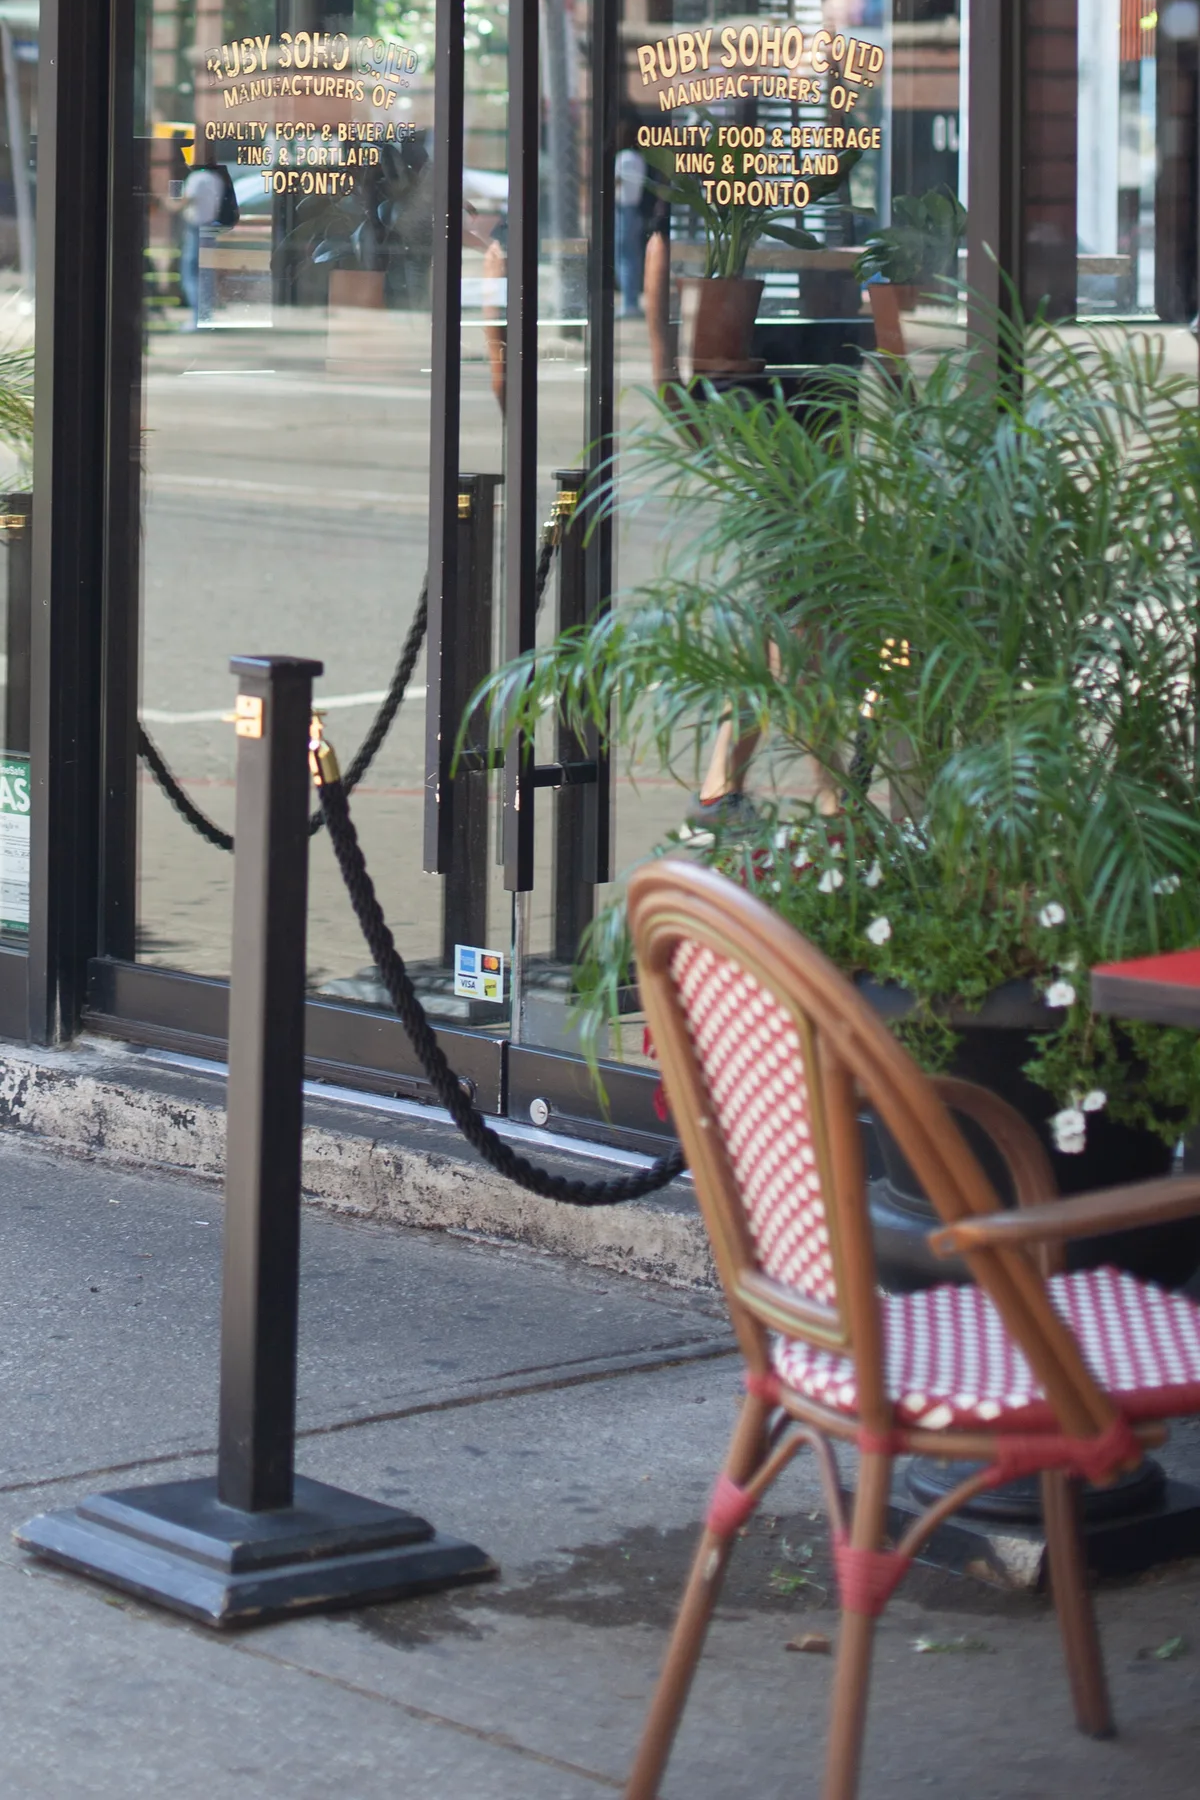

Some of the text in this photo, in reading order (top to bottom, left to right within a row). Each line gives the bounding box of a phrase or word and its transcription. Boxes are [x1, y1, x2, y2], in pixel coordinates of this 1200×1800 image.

[204, 34, 272, 86] RUBY
[277, 31, 350, 71] SOHO
[637, 28, 713, 86] RUBY
[720, 25, 804, 70] SOHO
[223, 75, 397, 110] MANUFACTURERS OF
[658, 74, 859, 113] MANUFACTURERS OF
[205, 121, 416, 144] QUALITY FOOD & BEVERAGE
[637, 126, 882, 150] QUALITY FOOD & BEVERAGE
[237, 146, 379, 167] KING & PORTLAND
[675, 153, 839, 176] KING & PORTLAND
[261, 170, 354, 196] TORONTO
[703, 180, 810, 208] TORONTO
[460, 979, 476, 990] VISA
